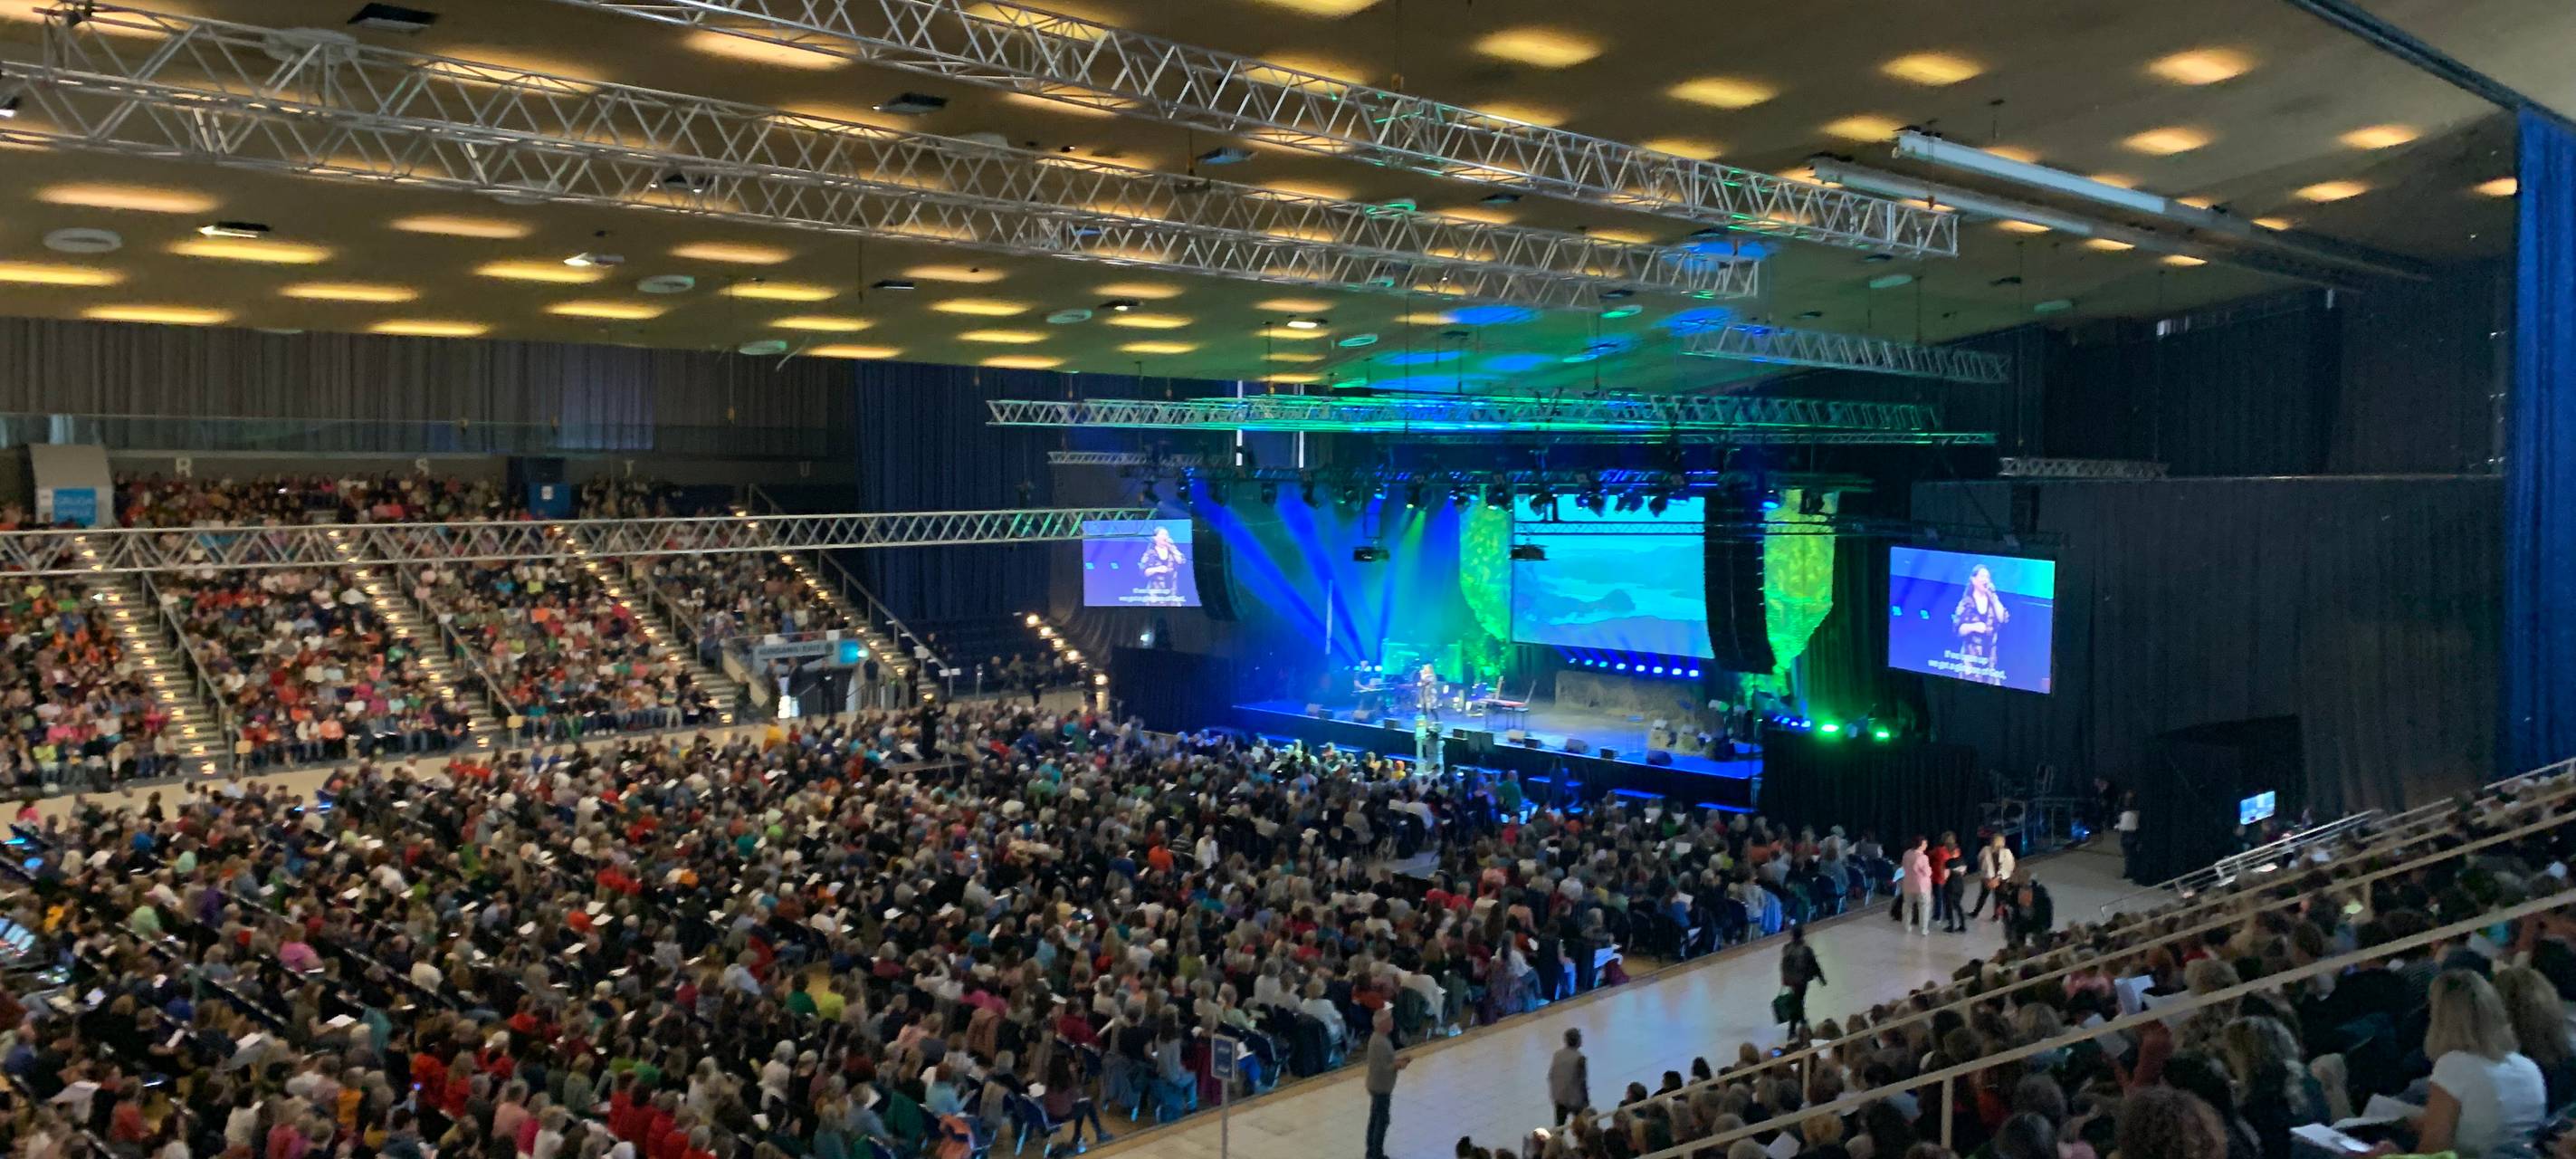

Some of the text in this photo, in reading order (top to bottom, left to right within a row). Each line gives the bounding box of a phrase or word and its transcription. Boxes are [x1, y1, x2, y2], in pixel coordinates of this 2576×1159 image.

[176, 456, 192, 477] R
[415, 456, 429, 476] S
[623, 455, 635, 477] T
[798, 456, 811, 477] U
